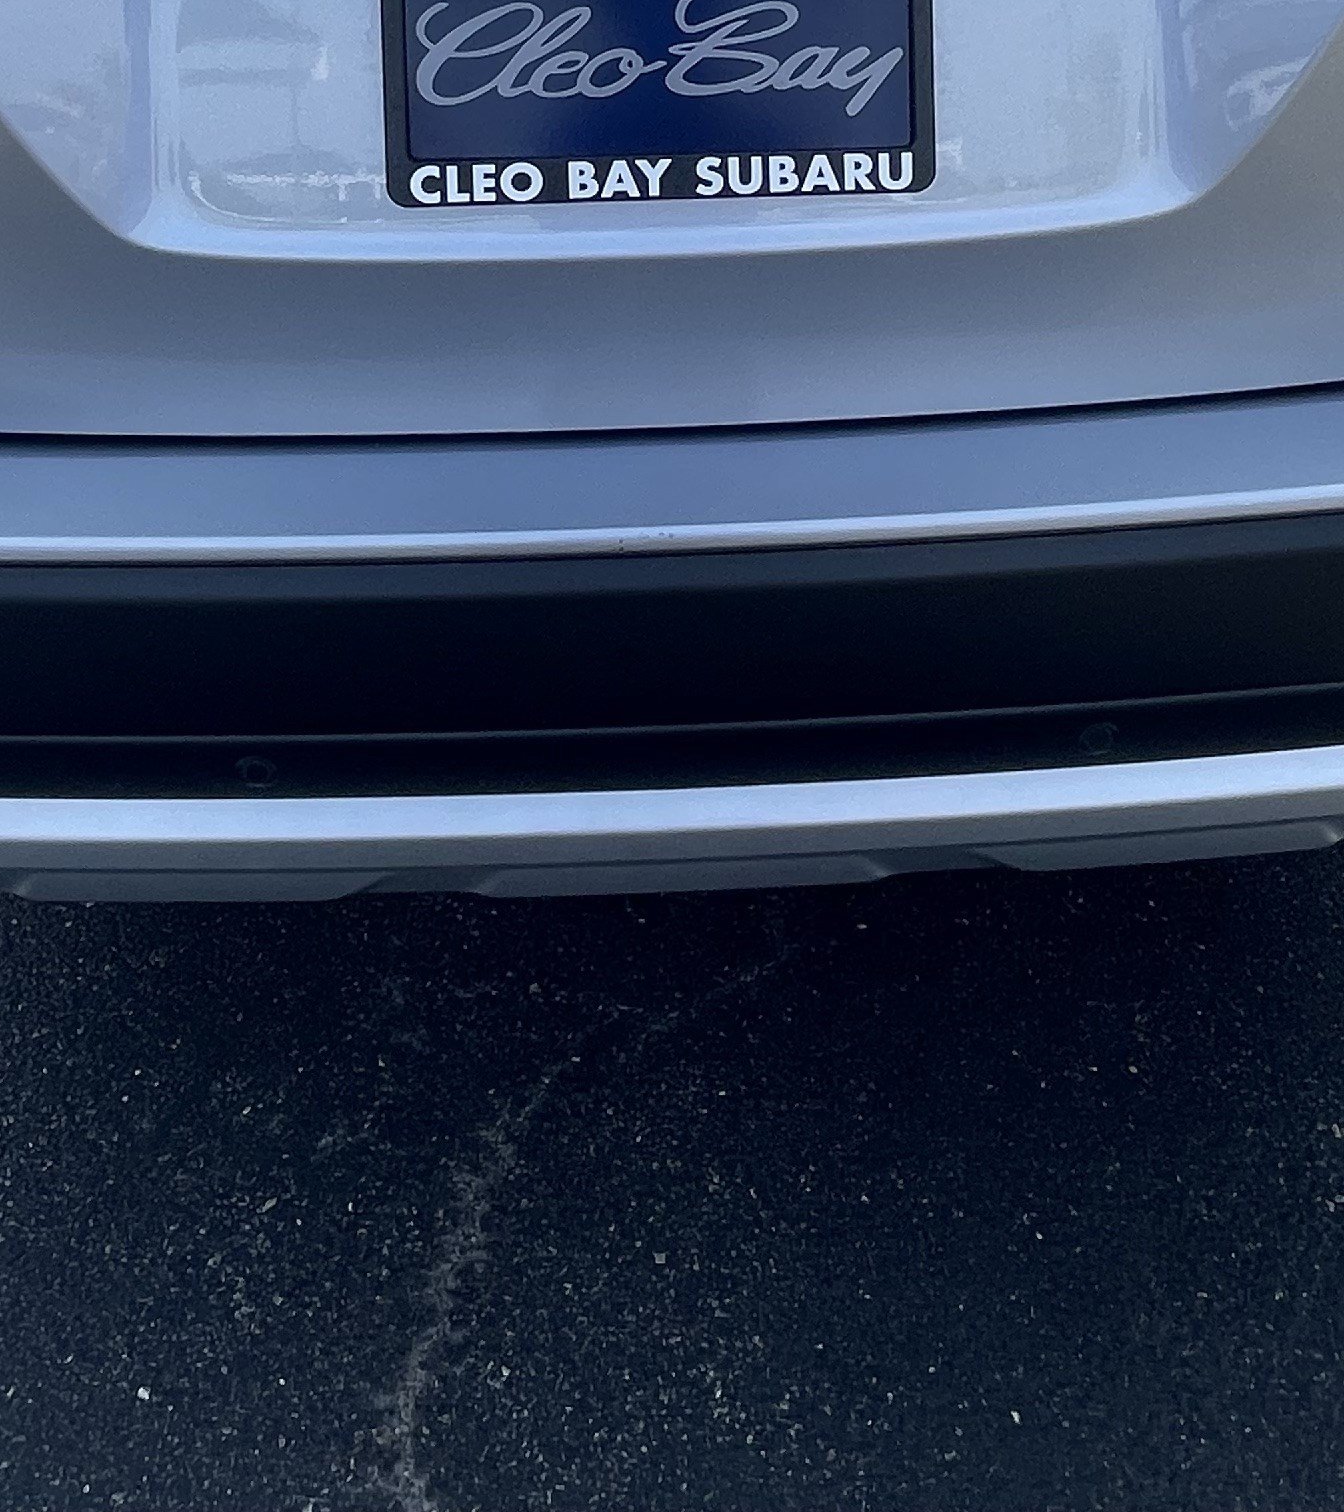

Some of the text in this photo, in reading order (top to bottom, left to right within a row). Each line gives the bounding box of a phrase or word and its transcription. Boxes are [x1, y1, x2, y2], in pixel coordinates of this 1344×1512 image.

[415, 1, 665, 106] Cleo
[409, 151, 914, 203] CLEO BAY SUBARU
